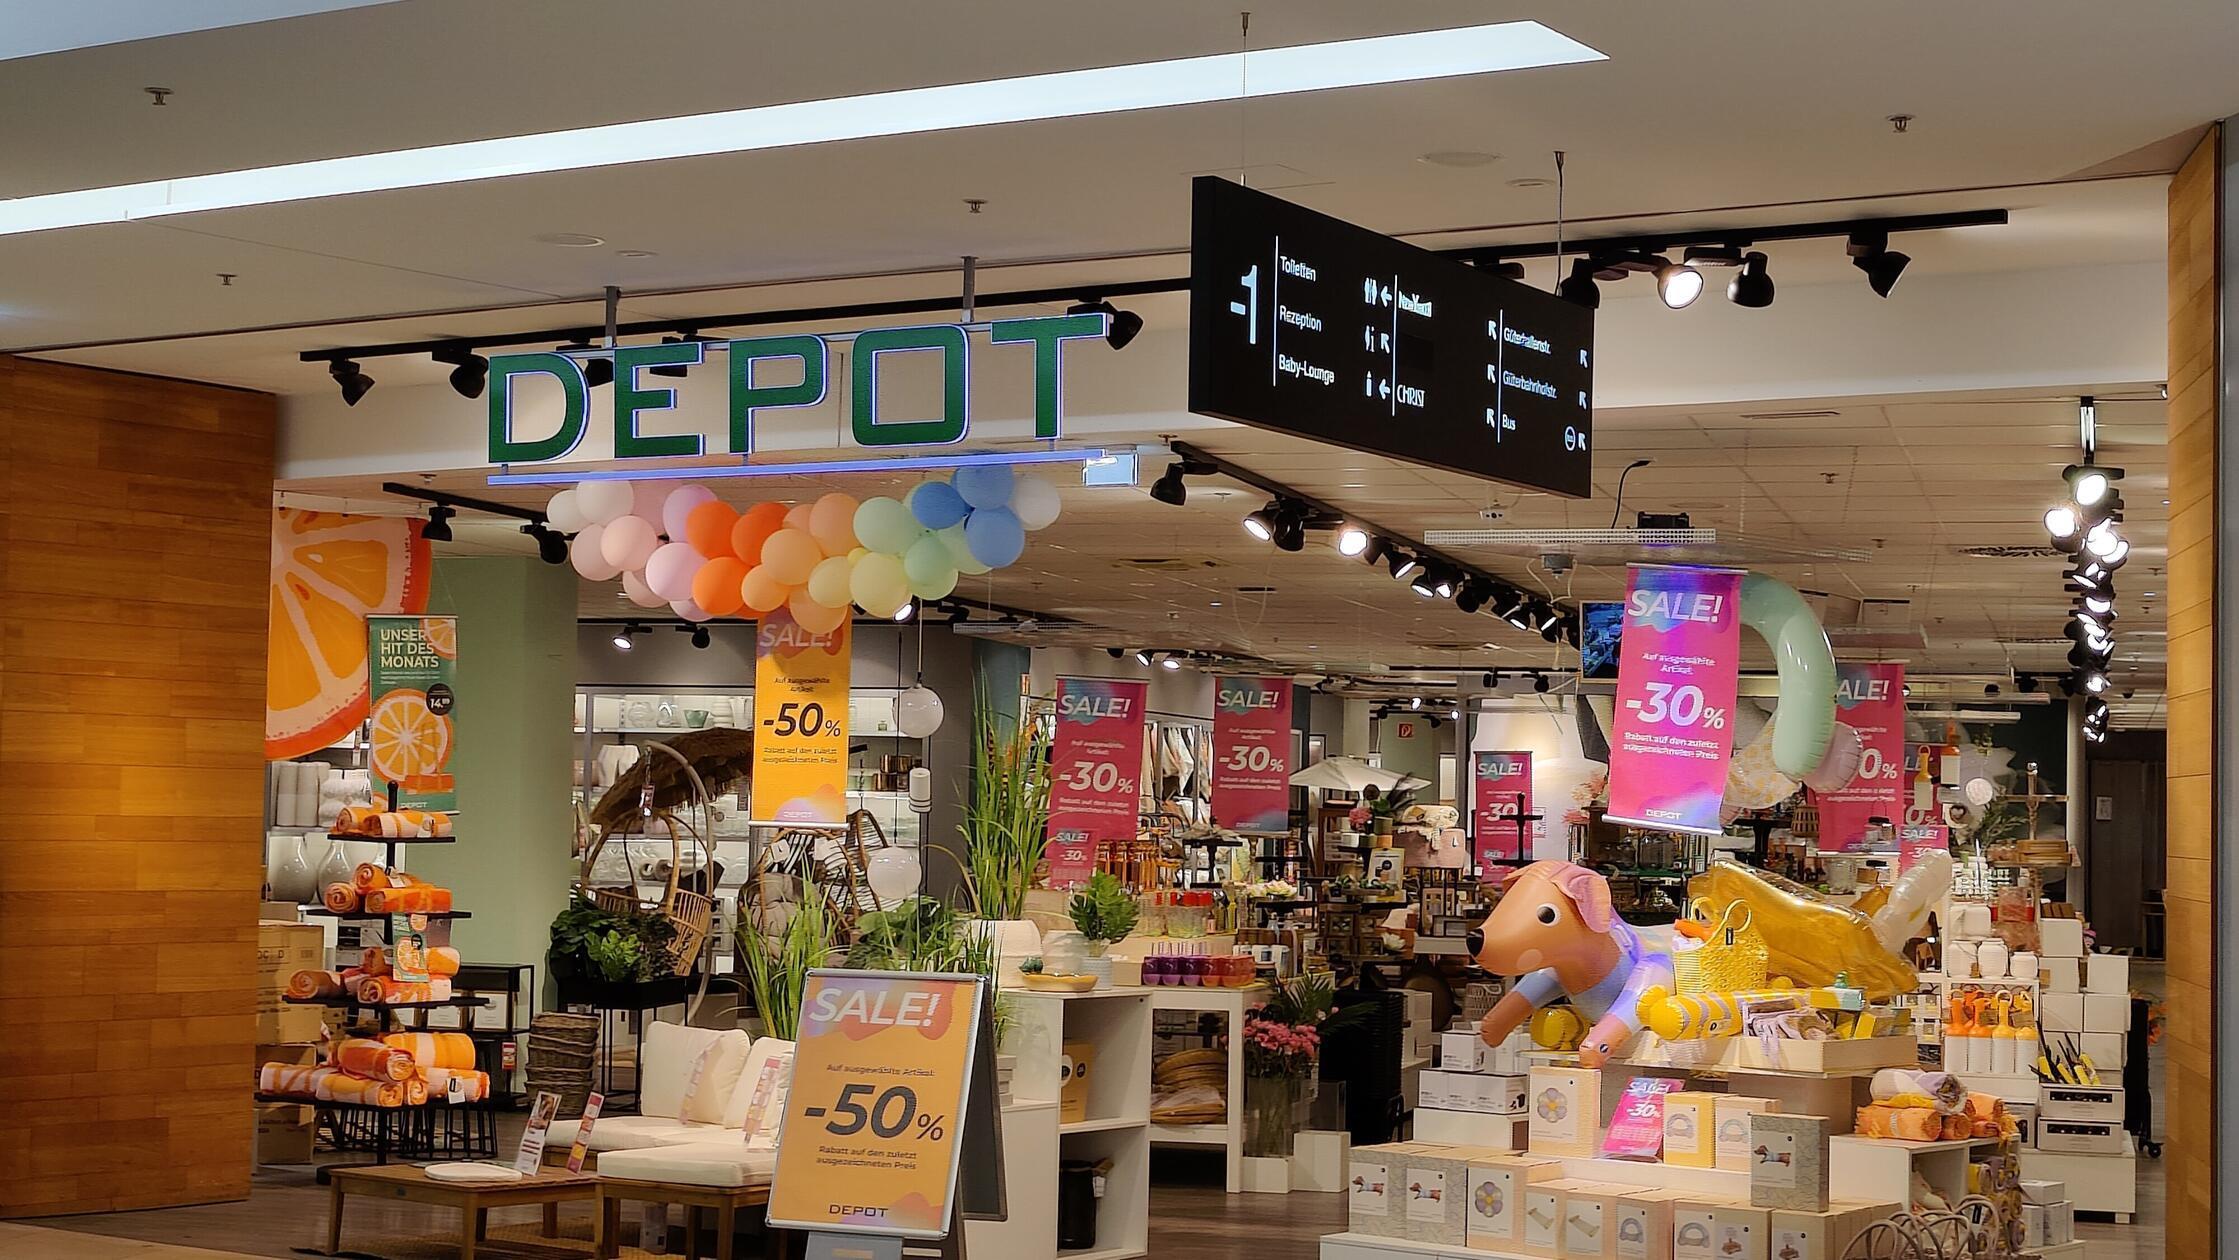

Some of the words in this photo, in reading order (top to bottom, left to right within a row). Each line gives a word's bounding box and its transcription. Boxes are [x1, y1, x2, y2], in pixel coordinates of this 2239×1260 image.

[1280, 255, 1317, 282] Toiletten
[1230, 264, 1258, 345] -1
[1279, 304, 1322, 332] Rezeption
[1278, 353, 1335, 386] Baby-Lounge
[488, 312, 1110, 463] DEPOT
[1396, 384, 1426, 408] CHRIST
[1502, 413, 1516, 431] Bus
[1628, 589, 1724, 624] SALE!
[380, 628, 427, 642] UNSER
[760, 623, 833, 648] SALE!
[380, 641, 402, 655] HIT
[407, 642, 434, 655] DES
[380, 655, 440, 668] MONATS
[1217, 690, 1280, 709] SALE!
[1837, 679, 1890, 701] ALE!
[1058, 694, 1131, 718] SALE!
[1626, 682, 1726, 729] -30%
[763, 703, 841, 737] -50%
[1219, 745, 1284, 772] -30%
[1476, 762, 1523, 776] SALE!
[1858, 748, 1897, 779] 0%
[1059, 761, 1133, 794] -30%
[1480, 802, 1520, 822] -30
[1901, 829, 1939, 840] SALE!
[808, 987, 942, 1027] SALE!
[804, 1083, 945, 1141] -50%
[819, 1146, 849, 1155] Rabatt
[850, 1148, 865, 1156] auf
[894, 1161, 917, 1170] Preis
[829, 1204, 889, 1218] DEPOT
